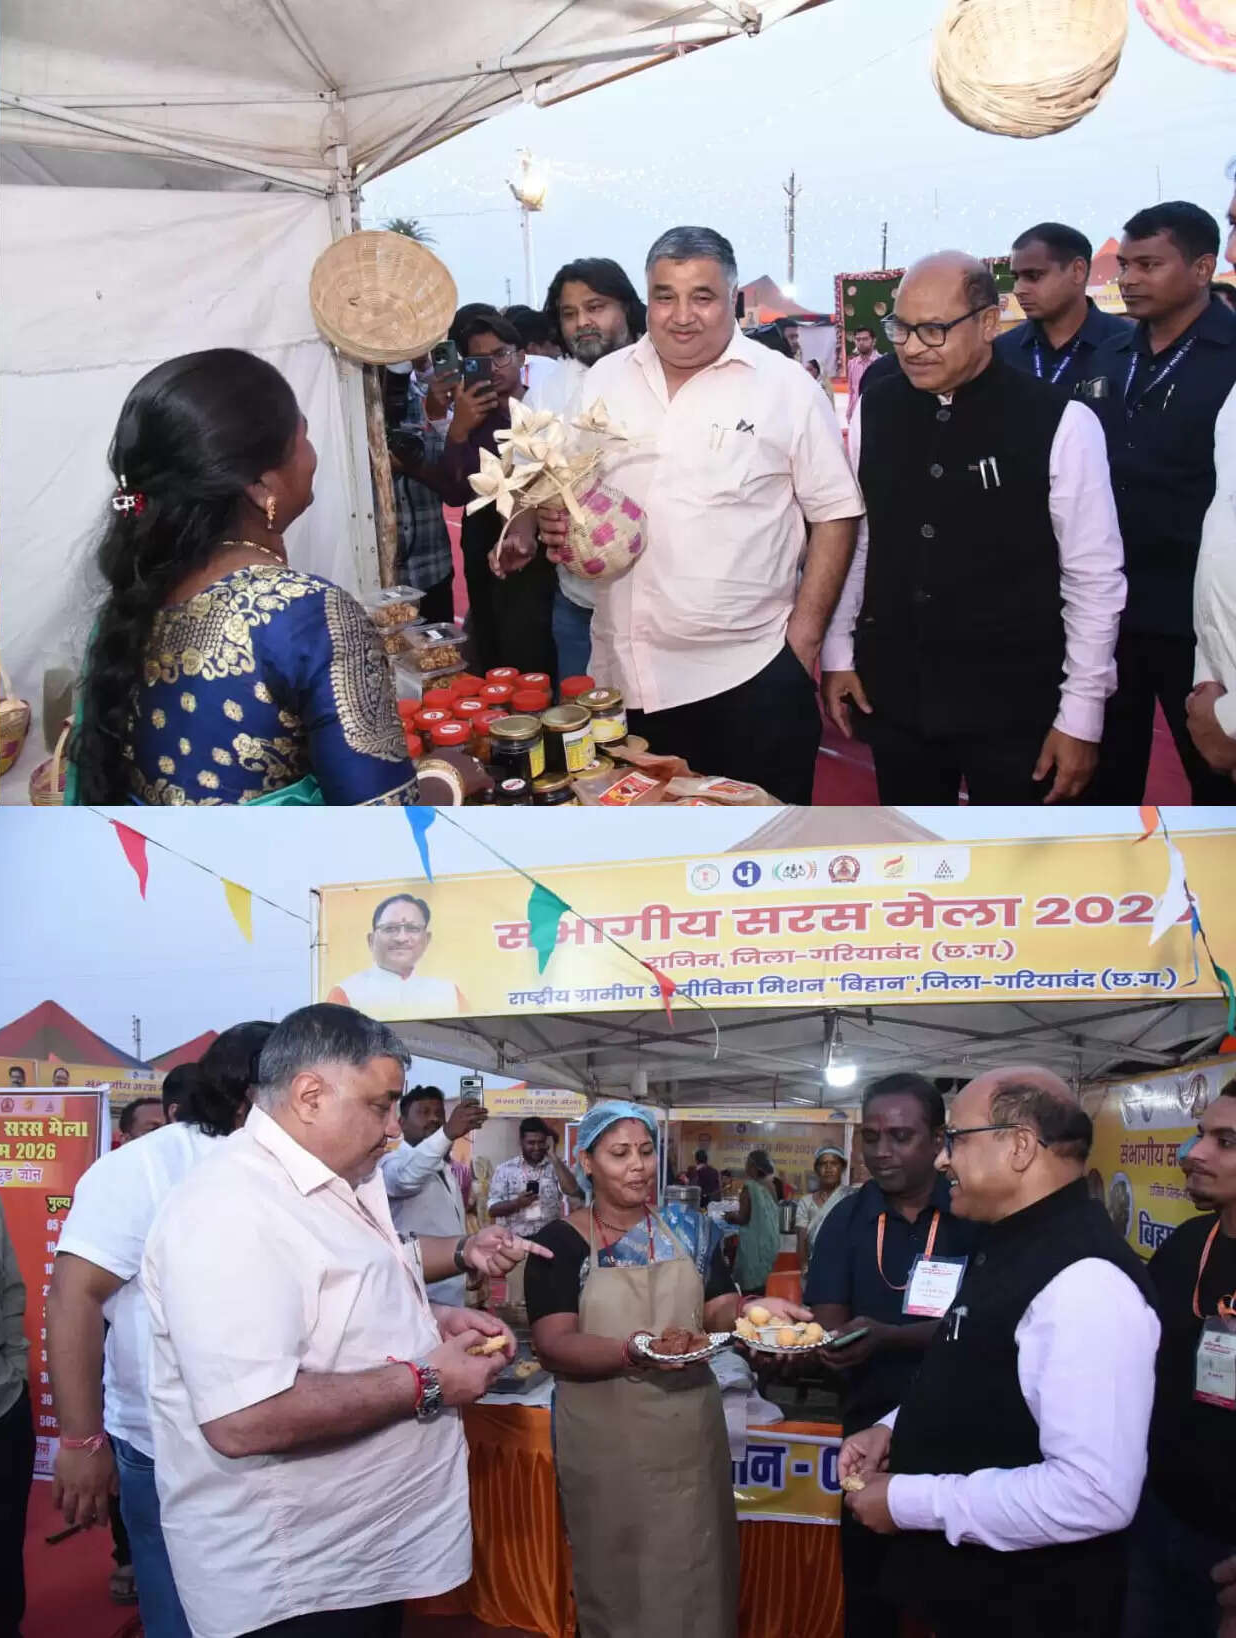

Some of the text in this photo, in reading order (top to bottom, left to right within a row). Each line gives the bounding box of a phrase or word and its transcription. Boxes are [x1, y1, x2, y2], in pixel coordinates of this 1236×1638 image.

[494, 904, 722, 950] सभागीय
[732, 903, 872, 935] सरस
[882, 892, 1022, 929] मेला
[508, 984, 570, 1005] राष्ट्रीय
[575, 983, 645, 1003] ग्रामीण
[758, 975, 825, 993] मिशन
[15, 1142, 57, 1160] 2026
